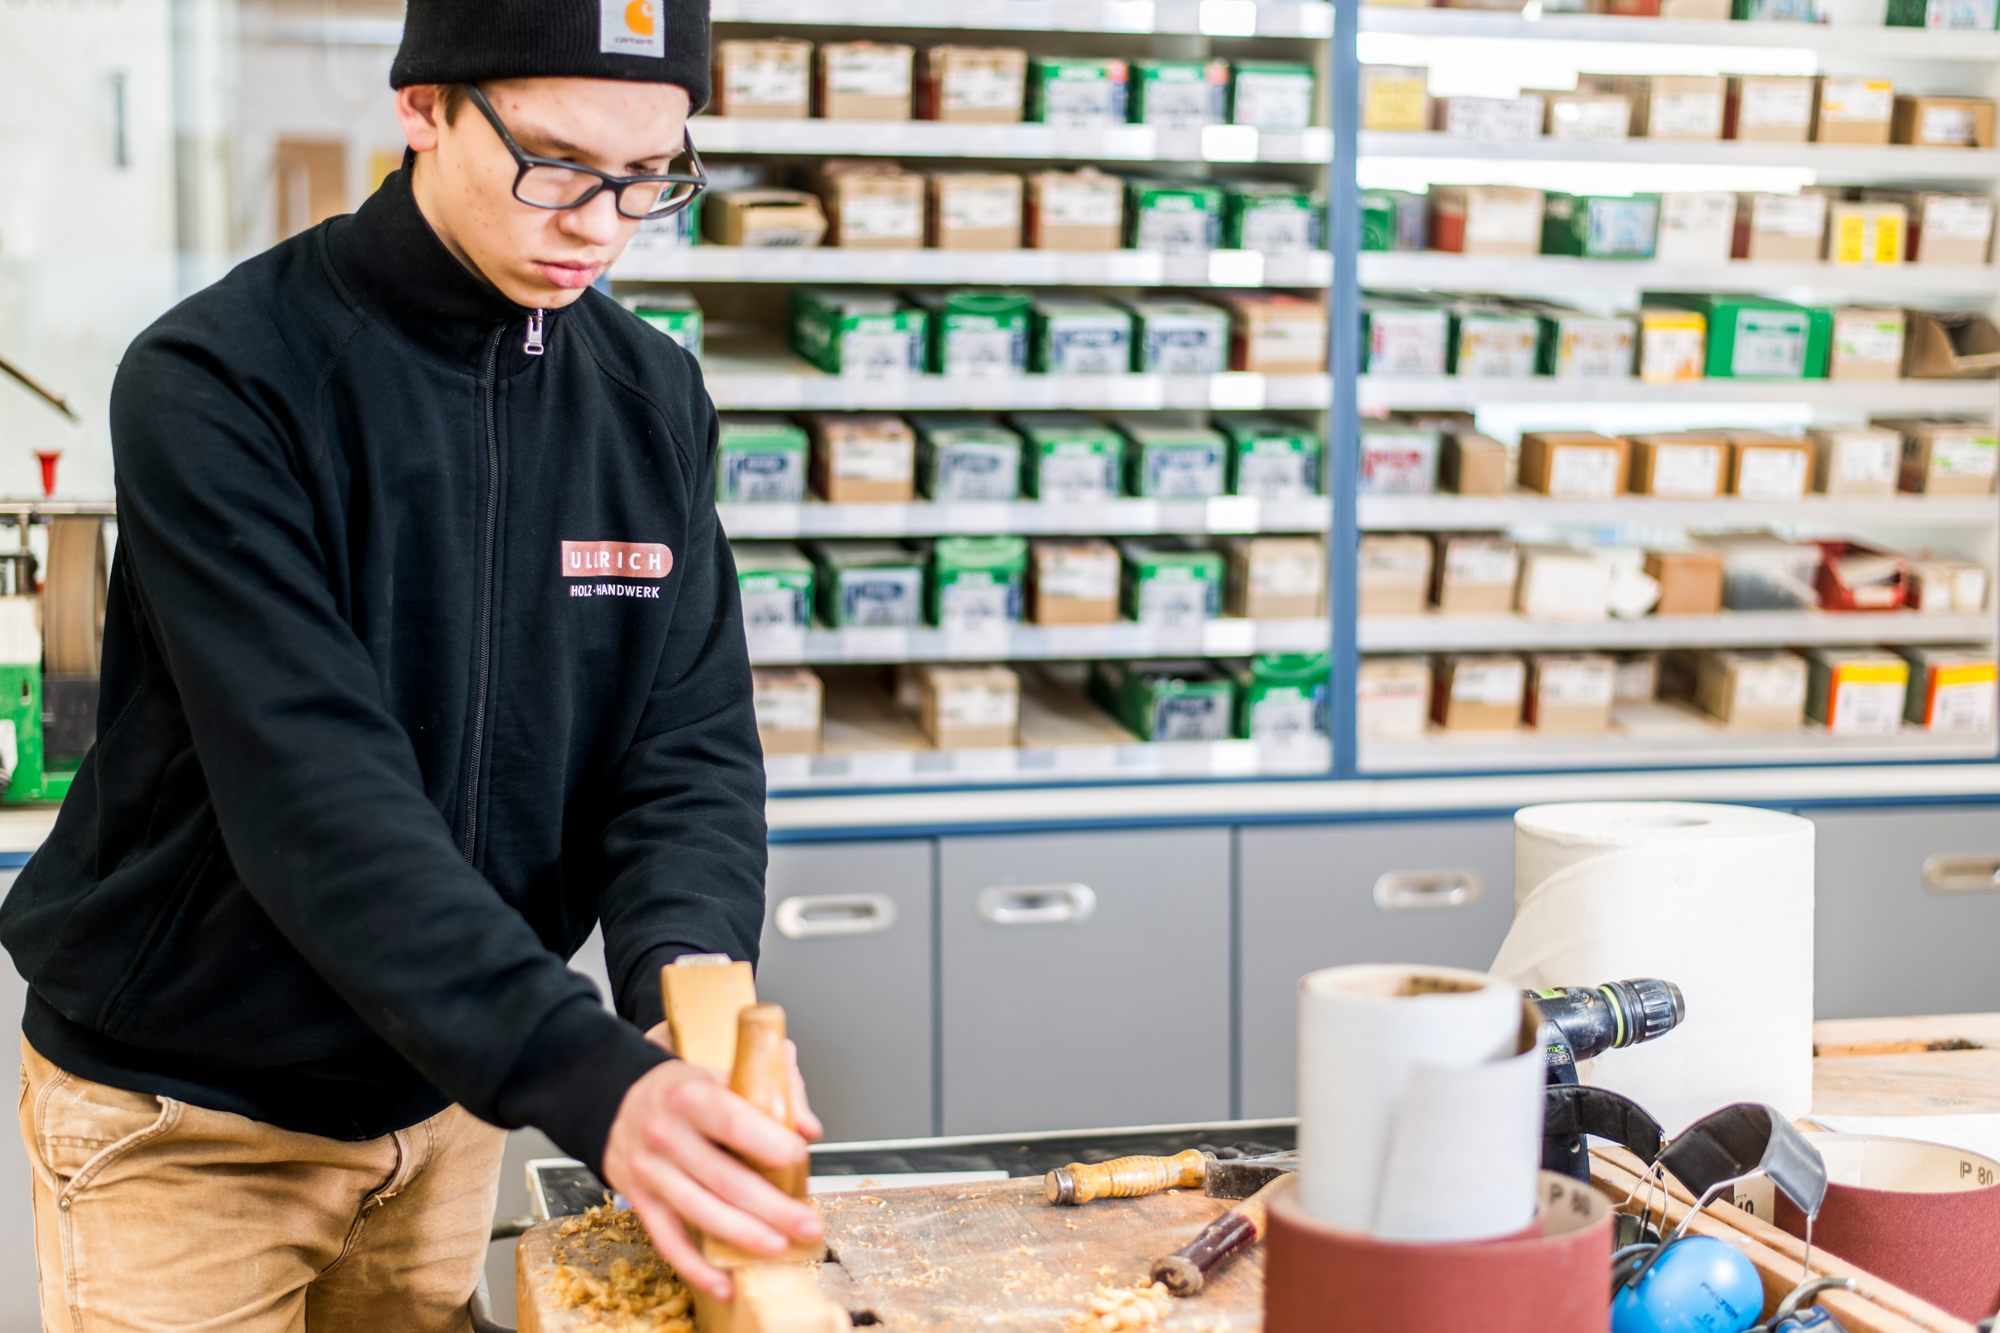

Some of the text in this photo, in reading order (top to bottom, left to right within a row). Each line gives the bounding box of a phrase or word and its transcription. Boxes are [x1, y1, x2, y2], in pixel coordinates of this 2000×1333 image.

[571, 551, 661, 570] ULLRICH
[1960, 1159, 1993, 1186] P 80
